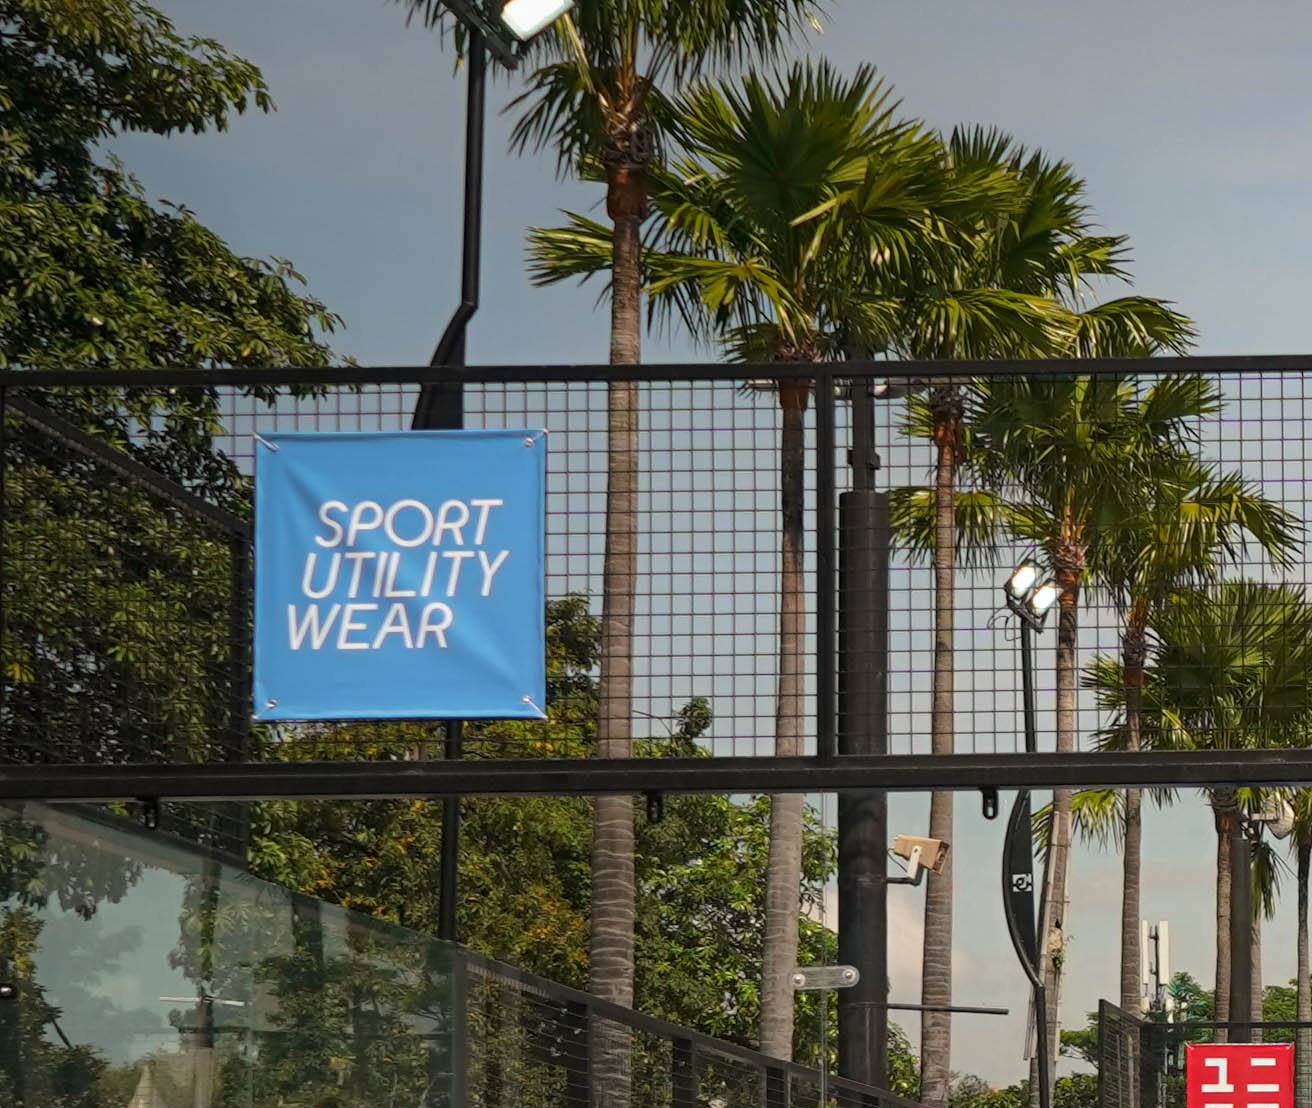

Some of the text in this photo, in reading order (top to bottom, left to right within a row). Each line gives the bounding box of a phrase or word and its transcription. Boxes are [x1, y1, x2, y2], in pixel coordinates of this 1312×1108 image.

[314, 499, 504, 547] SPORT
[302, 550, 510, 599] UTILITY
[287, 602, 453, 650] WEAR
